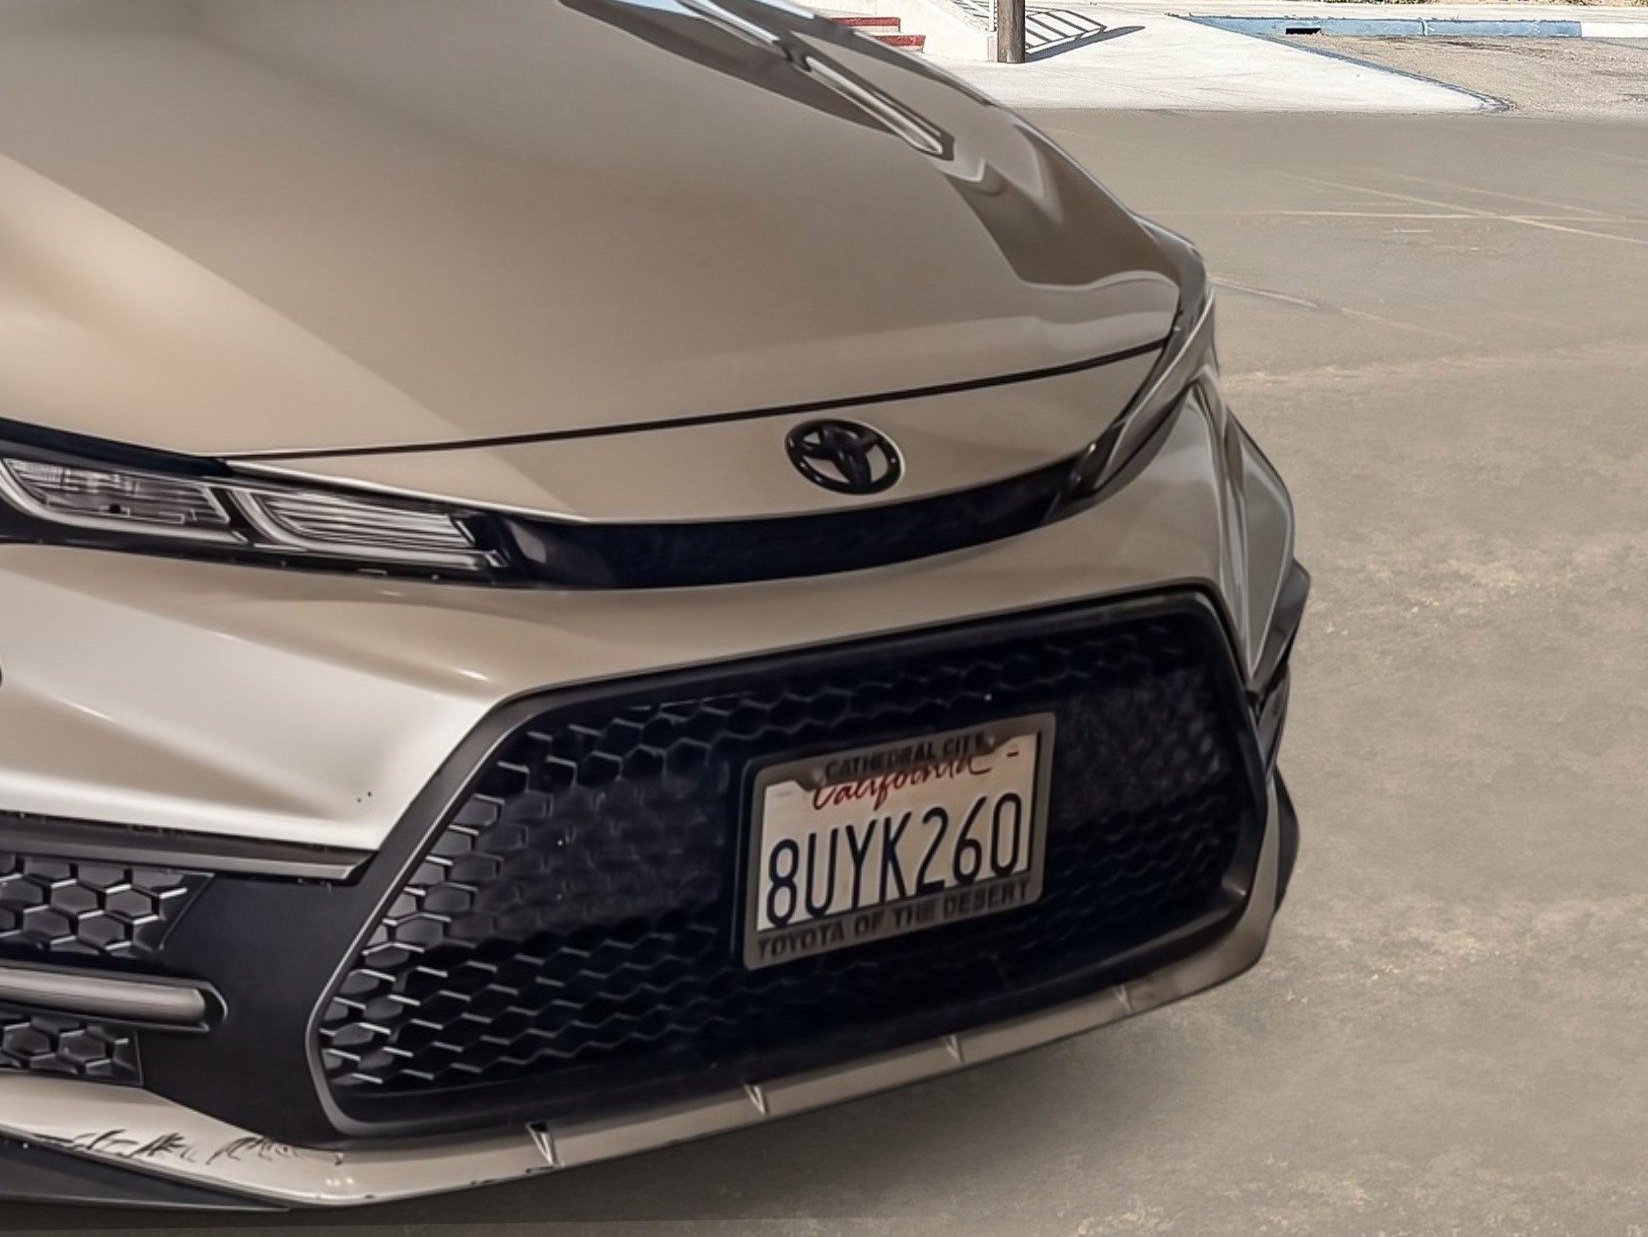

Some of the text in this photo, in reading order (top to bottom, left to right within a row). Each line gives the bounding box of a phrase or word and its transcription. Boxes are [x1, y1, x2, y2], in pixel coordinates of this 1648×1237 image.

[766, 792, 1022, 928] 8UYK260
[757, 879, 1031, 960] TOYOTA OF THE DESERT
